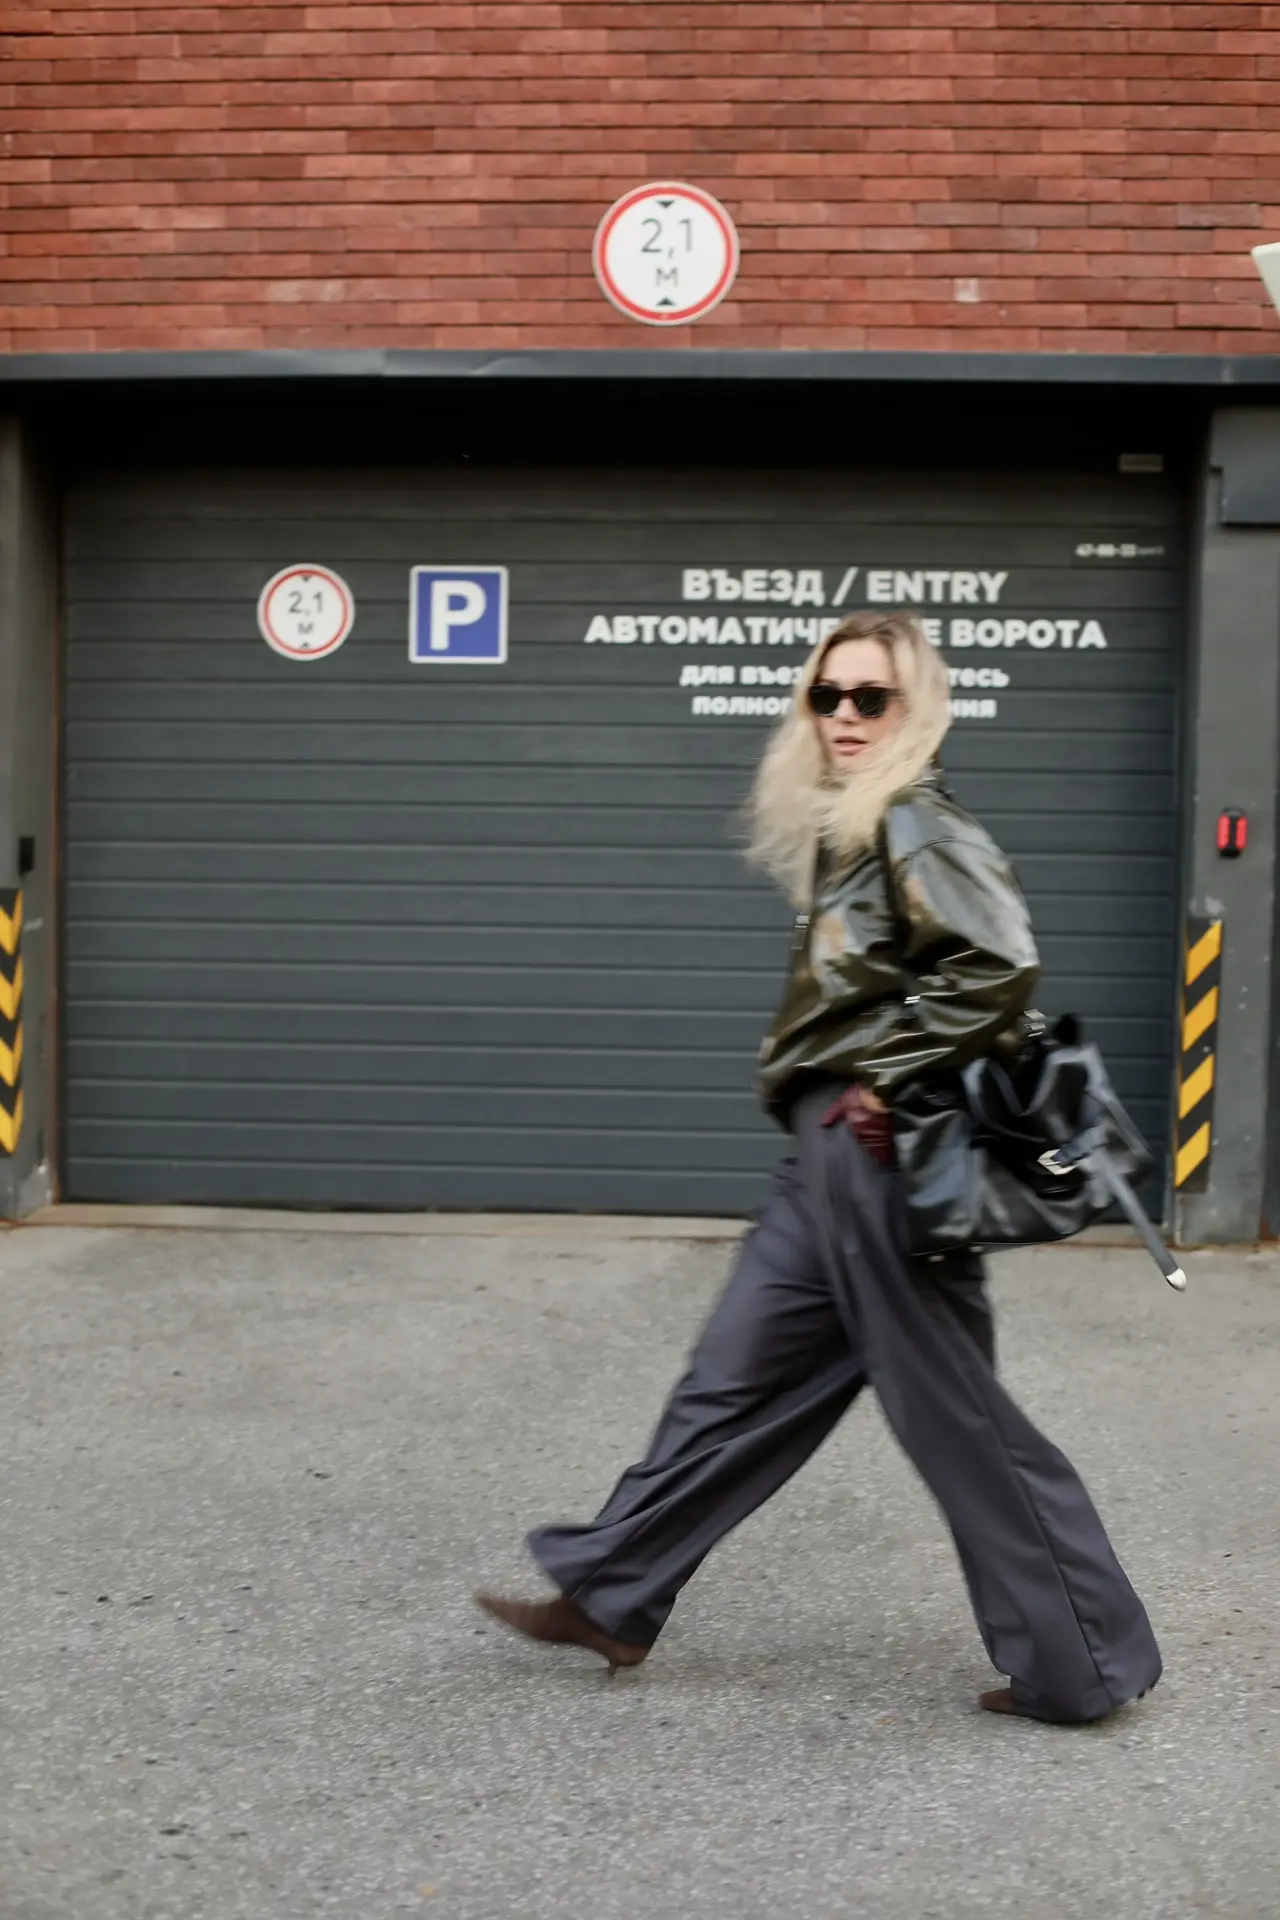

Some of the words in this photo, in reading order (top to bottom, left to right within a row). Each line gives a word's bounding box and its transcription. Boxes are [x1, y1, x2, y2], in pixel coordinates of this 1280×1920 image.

[640, 218, 693, 259] 2,1
[682, 568, 825, 606] ВЪЕЗД
[832, 567, 859, 606] /
[866, 571, 1008, 603] ENTRY
[288, 592, 325, 616] 2,1
[429, 580, 488, 651] P
[950, 618, 1108, 649] ВОРОТА
[679, 665, 736, 687] для
[739, 665, 803, 686] въез
[691, 695, 794, 716] полног
